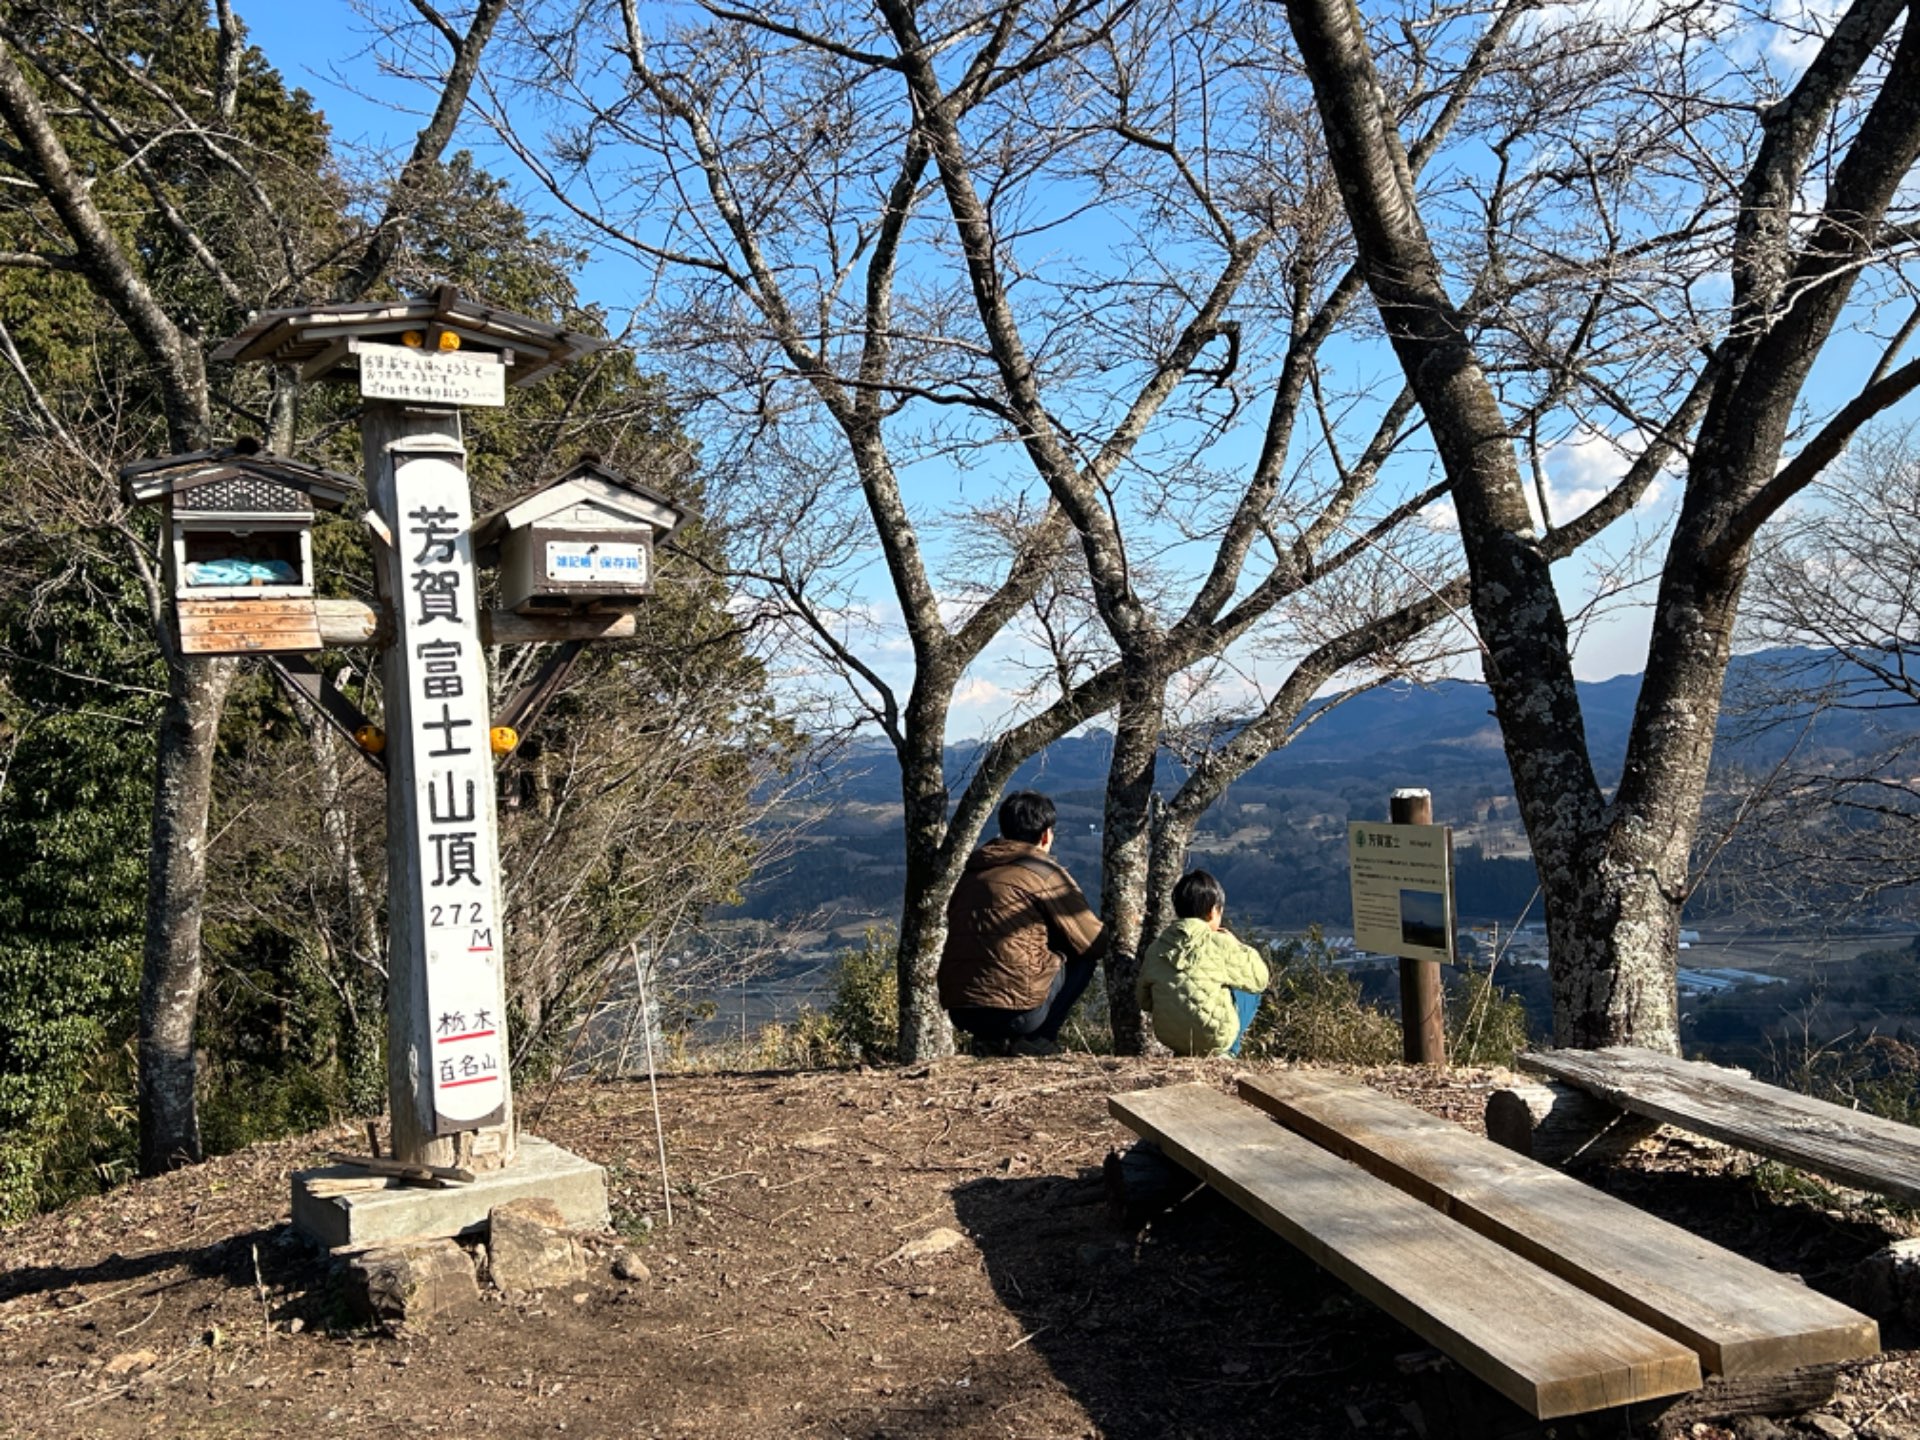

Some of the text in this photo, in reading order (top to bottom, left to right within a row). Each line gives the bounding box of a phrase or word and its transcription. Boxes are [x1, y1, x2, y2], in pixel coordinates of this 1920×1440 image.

[407, 505, 482, 887] 芳賀富士山頂
[430, 902, 483, 927] 272
[471, 927, 493, 947] M
[436, 1008, 496, 1034] 栃木
[439, 1053, 497, 1081] 百名山
